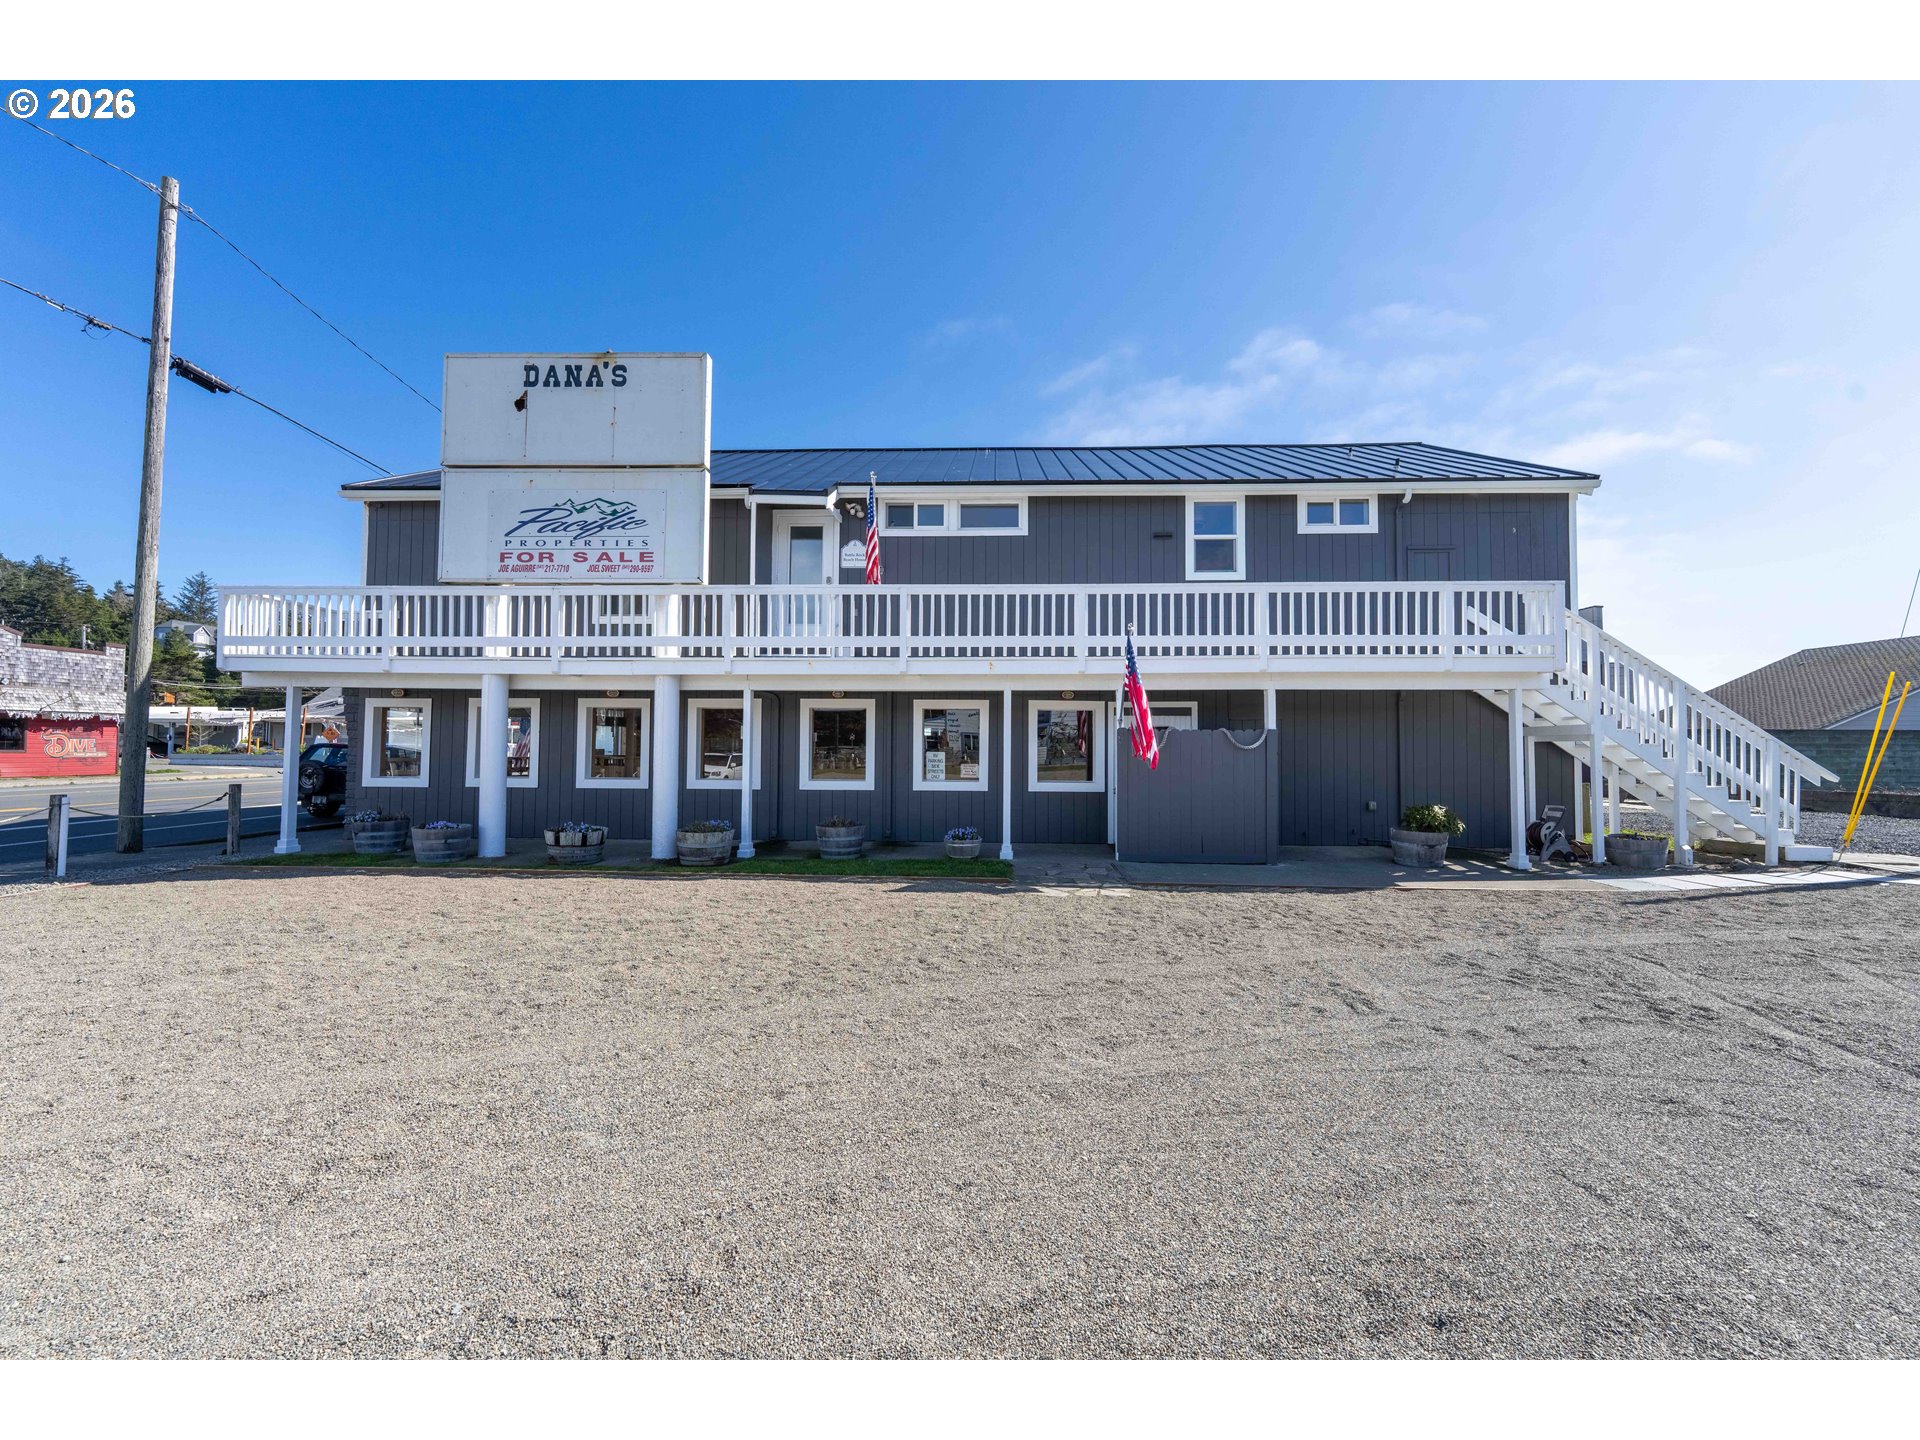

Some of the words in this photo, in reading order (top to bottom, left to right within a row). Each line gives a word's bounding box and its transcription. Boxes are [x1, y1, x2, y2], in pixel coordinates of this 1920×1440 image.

[523, 361, 628, 388] DANA'S
[504, 507, 648, 540] Pacific
[504, 539, 649, 547] PROPERTIES
[499, 551, 554, 563] FOR
[572, 551, 655, 563] SALE
[498, 564, 510, 573] JOE
[510, 564, 536, 573] AGUIRRE
[544, 564, 570, 573] 217-7710
[587, 564, 600, 573] JOEL
[600, 564, 621, 573] SWEET
